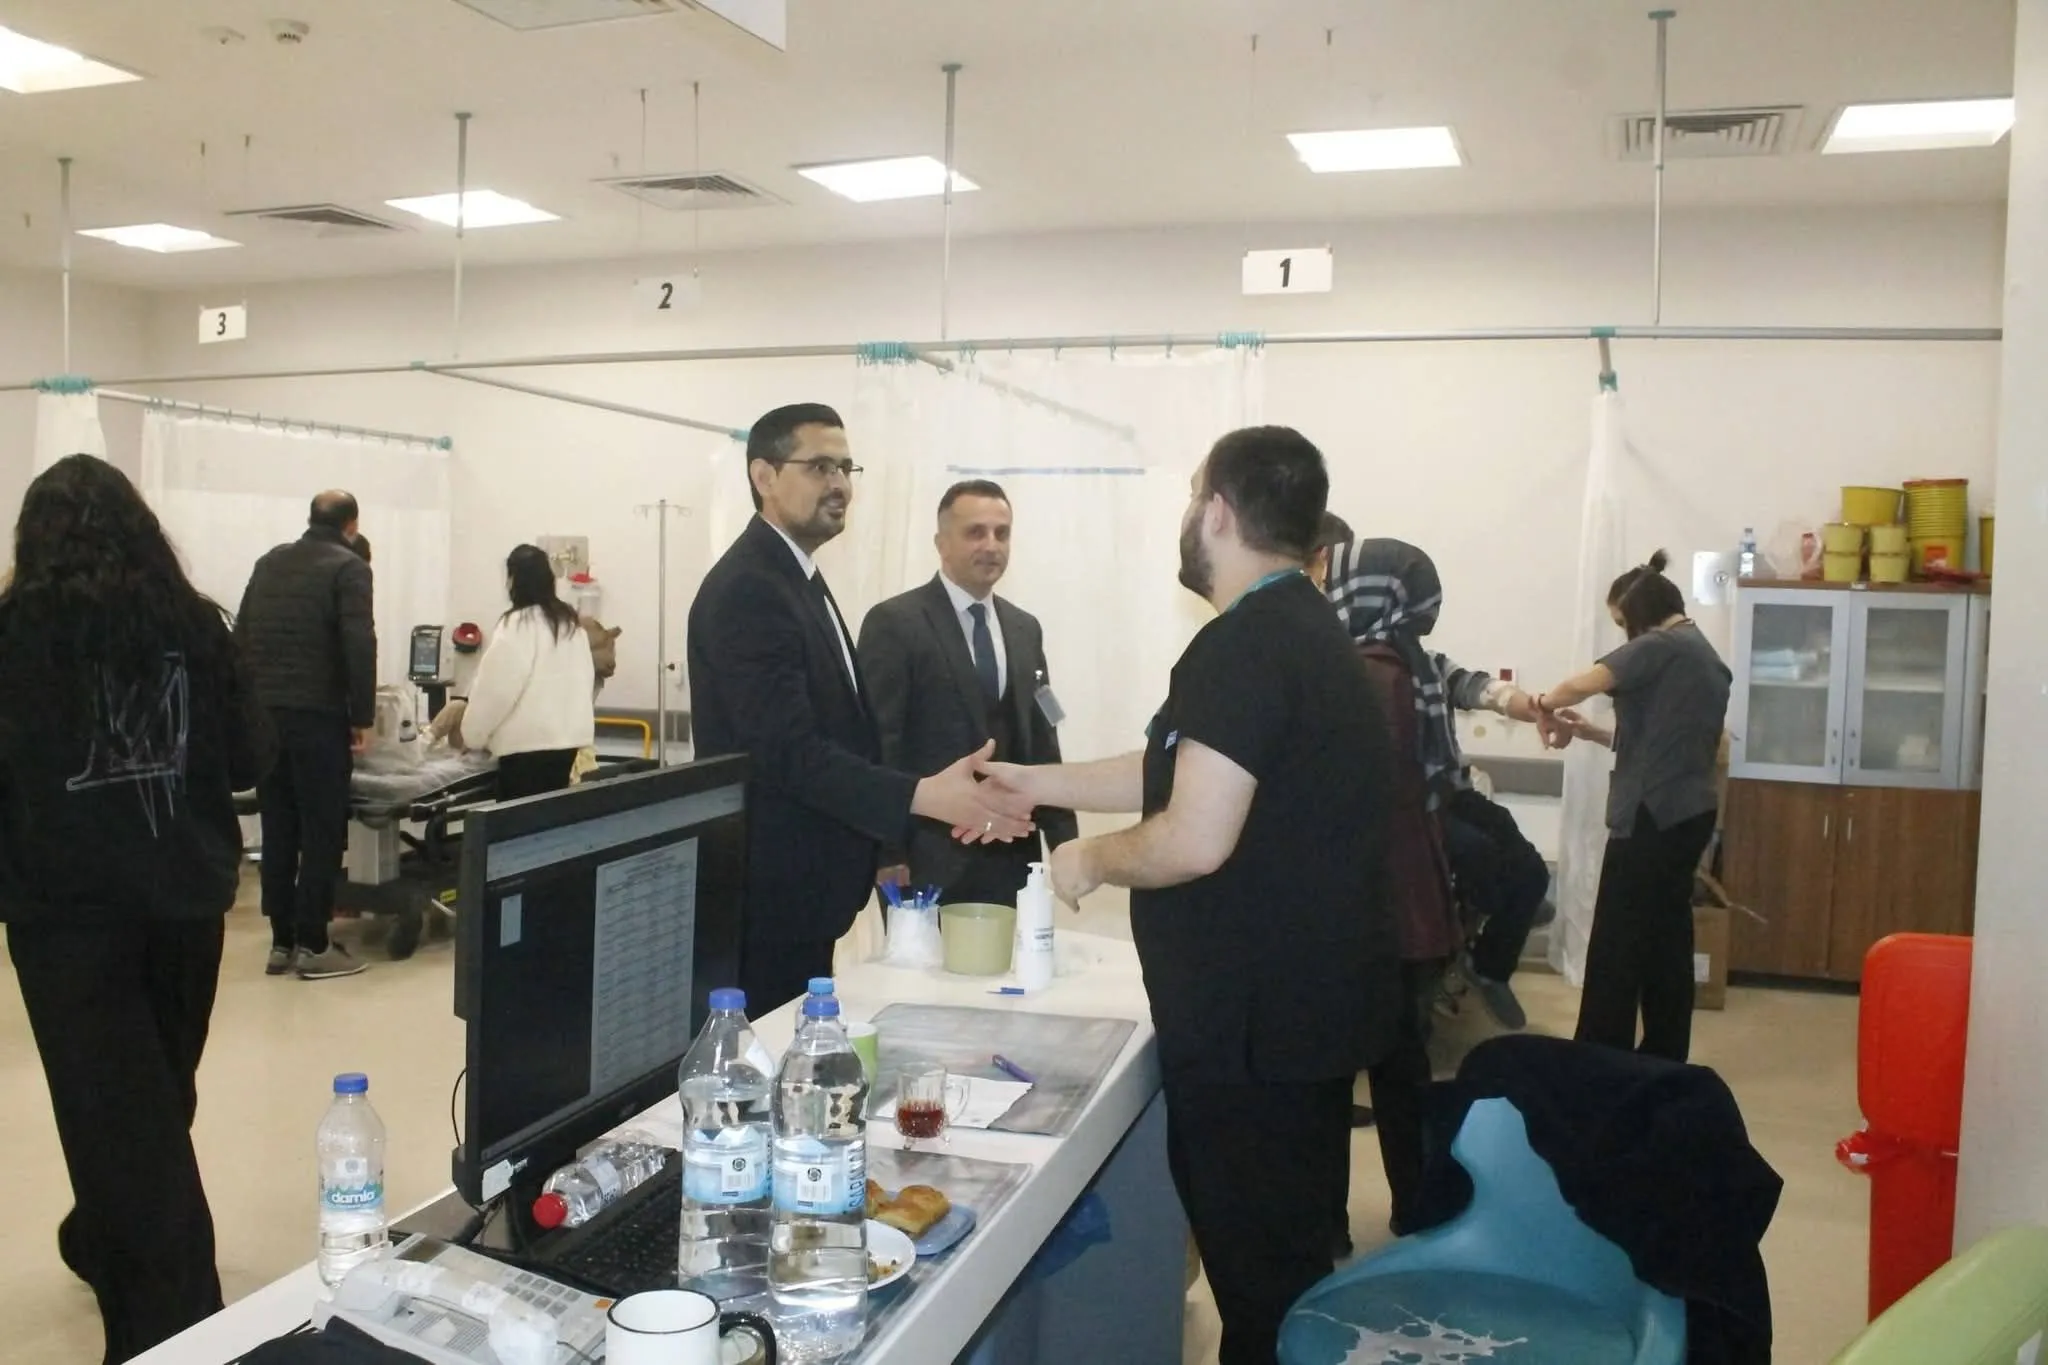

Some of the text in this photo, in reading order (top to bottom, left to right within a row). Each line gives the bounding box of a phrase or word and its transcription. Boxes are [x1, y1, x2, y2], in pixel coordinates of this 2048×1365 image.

[1280, 258, 1291, 288] 1
[658, 282, 673, 309] 2
[217, 311, 226, 336] 3
